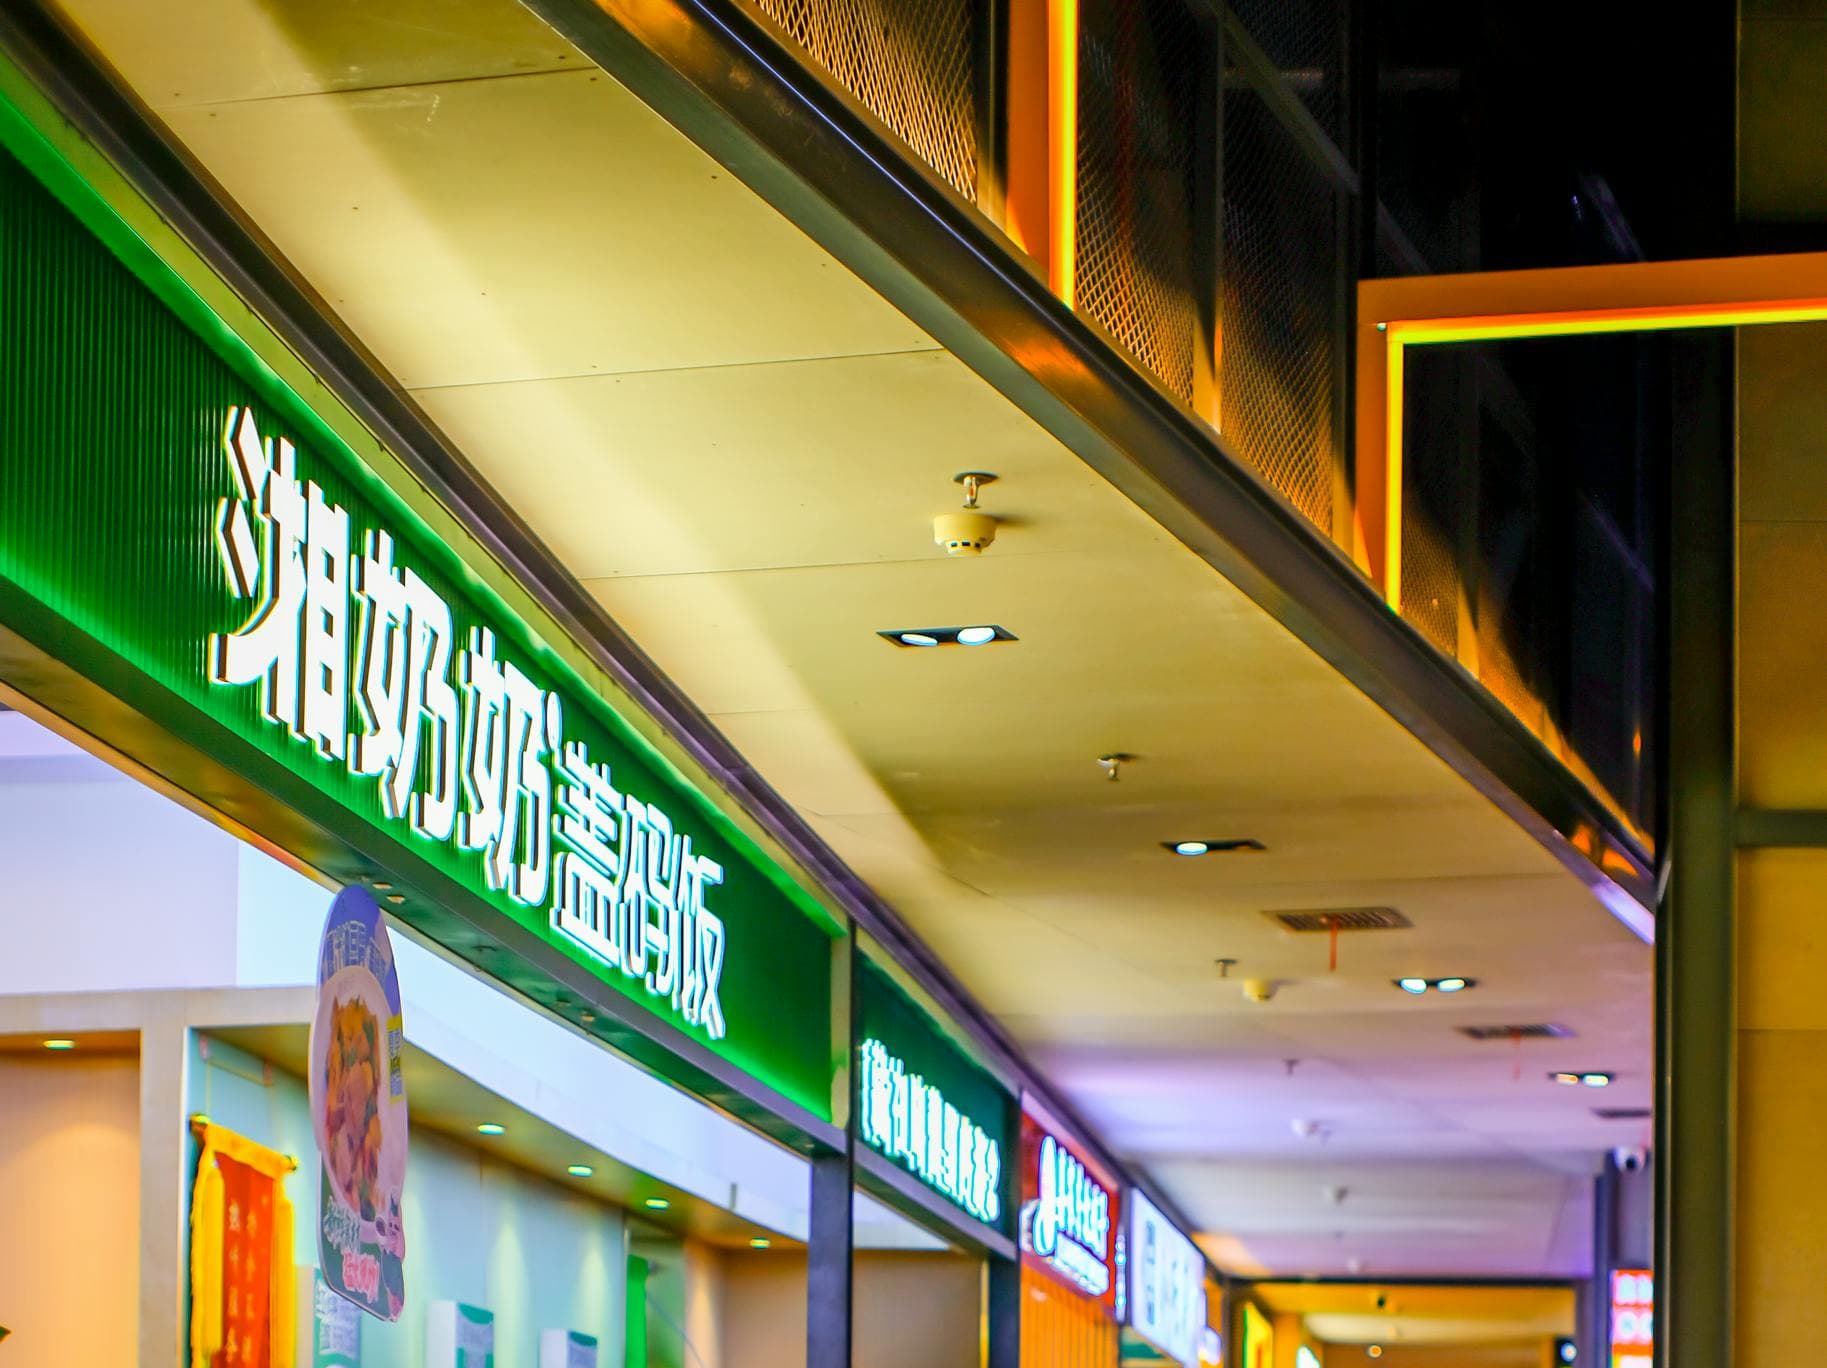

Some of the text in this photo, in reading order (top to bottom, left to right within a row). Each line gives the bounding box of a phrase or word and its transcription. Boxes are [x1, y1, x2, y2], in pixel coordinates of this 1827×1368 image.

[208, 405, 727, 1041] 湘奶奶盖码饭
